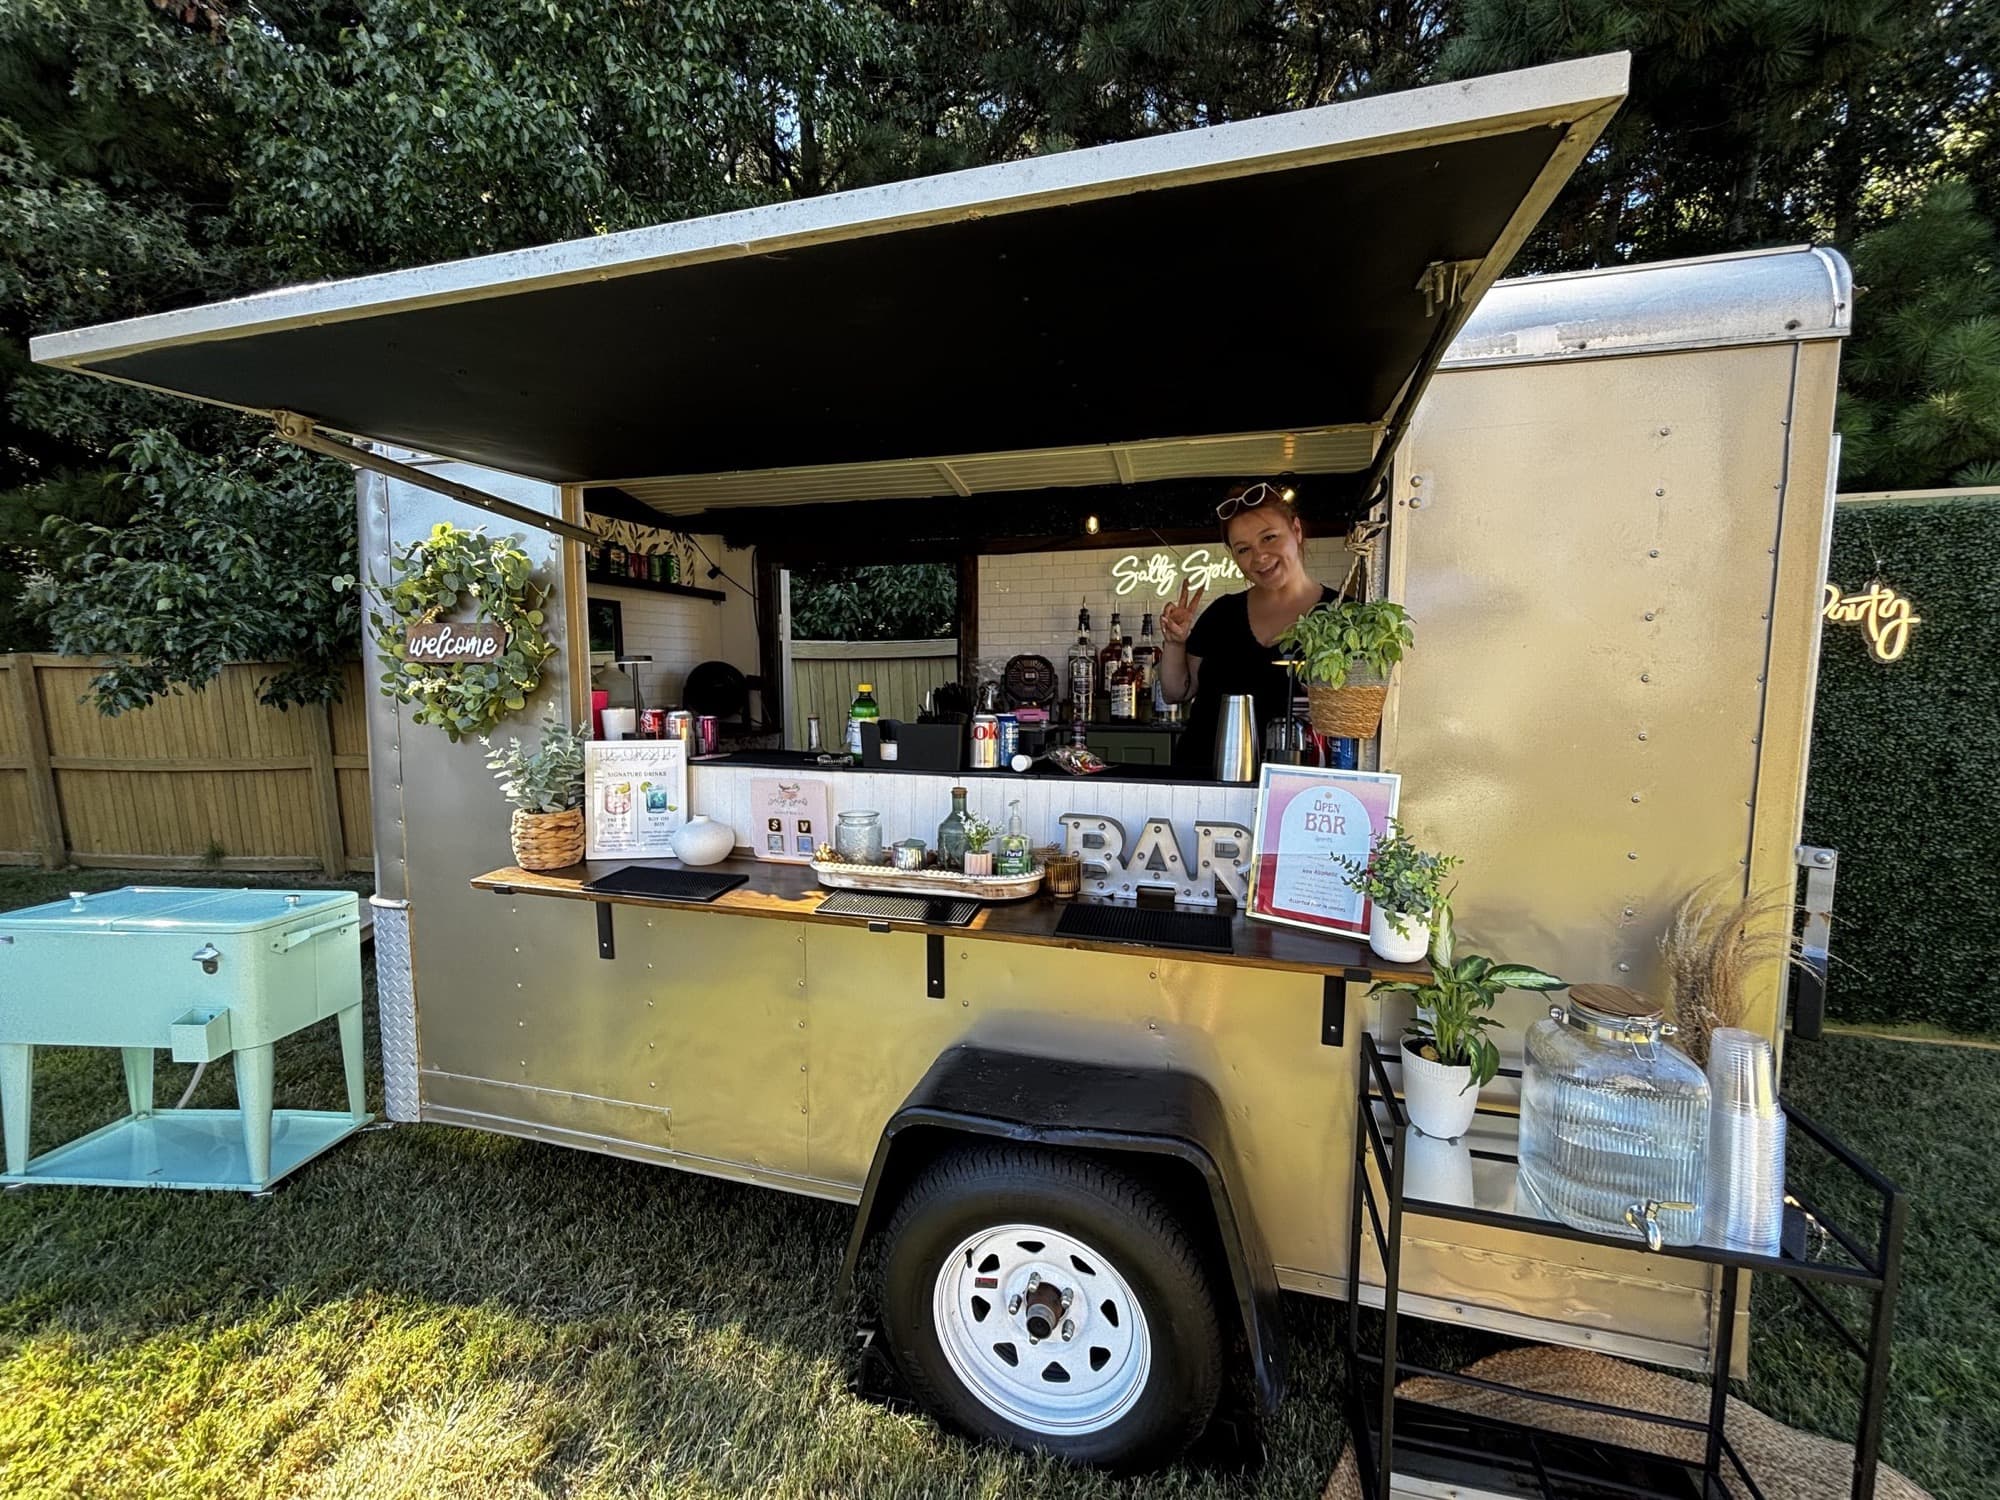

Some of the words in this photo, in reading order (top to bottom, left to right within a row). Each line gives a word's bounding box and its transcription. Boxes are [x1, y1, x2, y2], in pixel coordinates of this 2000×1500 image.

[1112, 553, 1178, 596] Salty
[409, 626, 498, 659] welcome
[1314, 799, 1341, 814] OPEN
[1304, 812, 1346, 836] BAR
[1059, 812, 1253, 910] BAR
